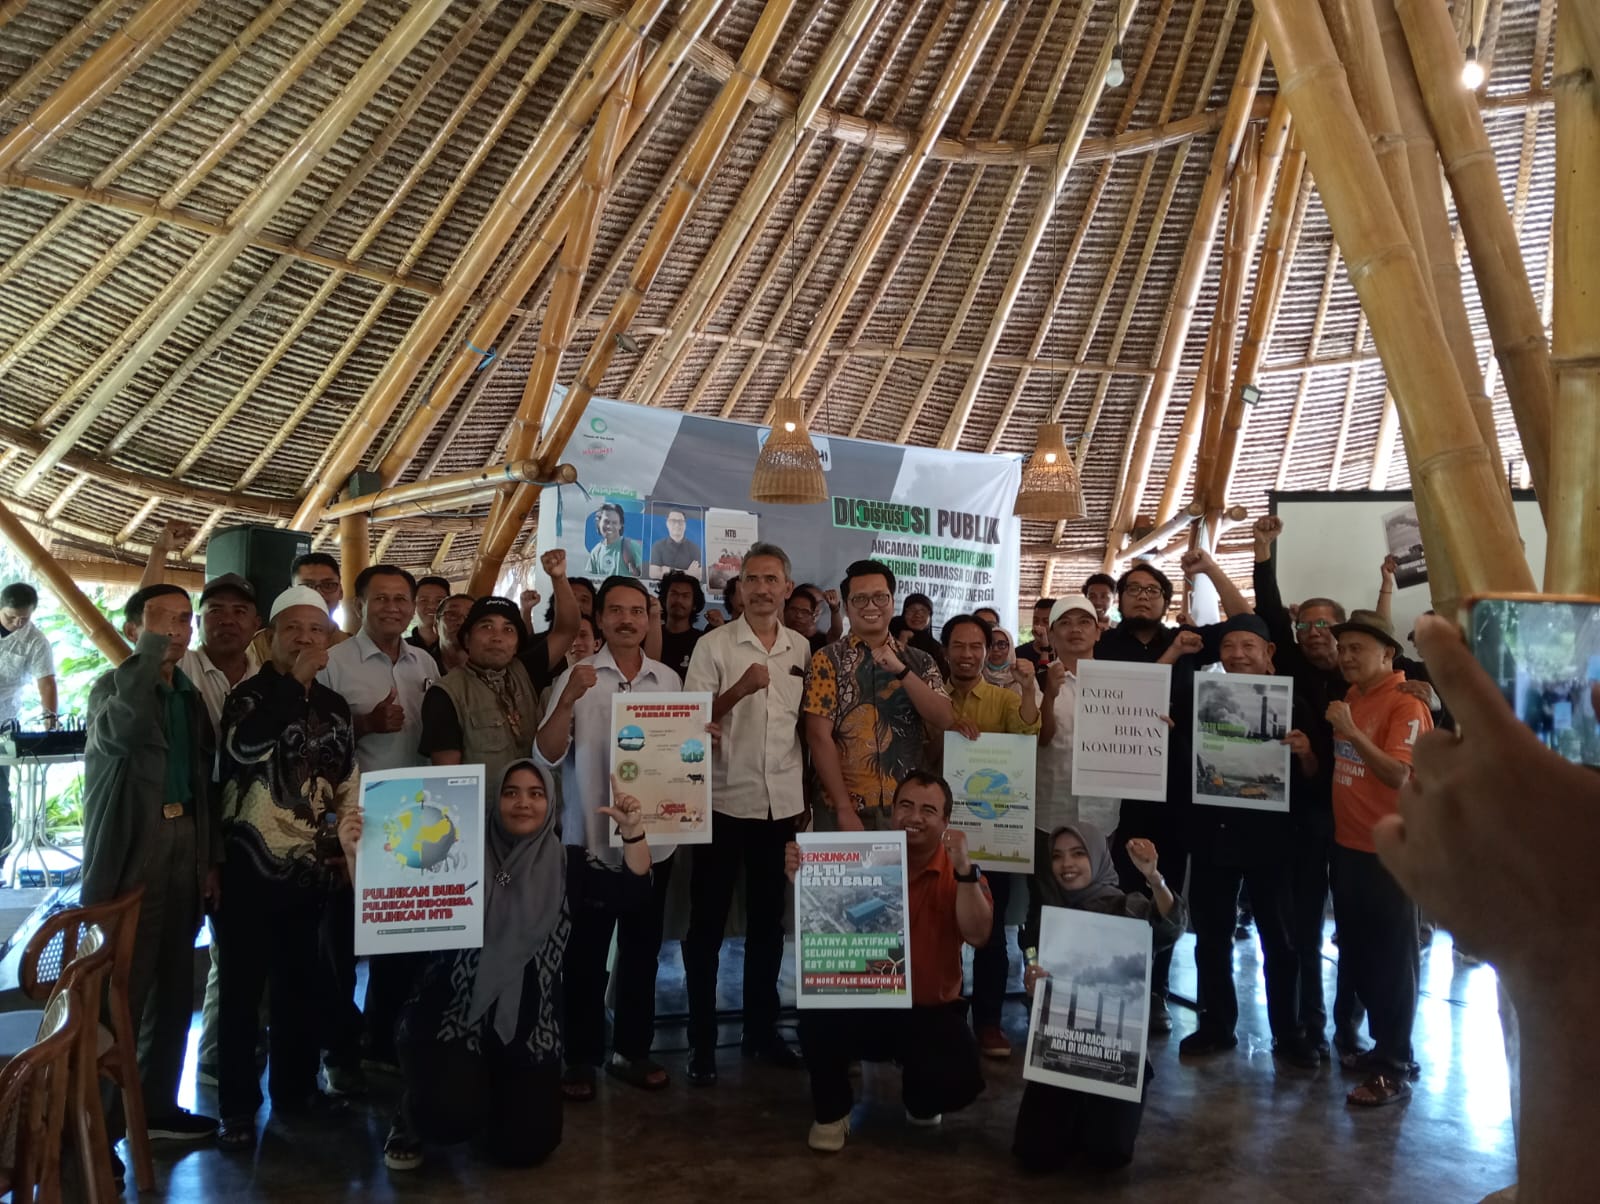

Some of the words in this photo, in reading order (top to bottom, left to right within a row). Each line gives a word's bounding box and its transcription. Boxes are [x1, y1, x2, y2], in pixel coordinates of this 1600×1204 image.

[937, 509, 1001, 545] PUBLIK
[872, 540, 919, 558] ANCAMAN
[921, 545, 942, 560] PLTU
[944, 547, 975, 566] CAPTIVE
[976, 553, 992, 568] DAN
[920, 564, 964, 581] BIOMASSA
[898, 580, 926, 595] PALSU
[965, 588, 995, 602] ENERGI
[1081, 688, 1123, 699] ENERGI
[1082, 704, 1131, 716] ADALAH
[1133, 707, 1159, 717] HAK
[1115, 725, 1161, 738] BUKAN
[801, 852, 860, 862] PENSIUNKAN
[802, 864, 846, 876] PLTU
[802, 876, 841, 886] BATU
[842, 876, 883, 886] BARA
[363, 885, 430, 900] PULIHKAN
[432, 884, 466, 896] BUMI
[363, 900, 415, 911] PULIHKAN
[362, 909, 426, 923] PULIHKAN
[429, 908, 453, 920] NTB
[805, 937, 847, 946] SAATNYA
[851, 937, 896, 946] AKTIFKAN
[805, 948, 845, 958] SELURUH
[848, 947, 887, 957] POTENSI
[805, 960, 823, 969] EBT
[826, 960, 835, 968] DI
[838, 960, 857, 968] NTB
[805, 977, 814, 985] NO
[816, 977, 834, 985] MORE
[836, 977, 857, 985] FALSE
[860, 977, 891, 985] SOLUTION
[1050, 1038, 1067, 1052] ADA
[1068, 1041, 1077, 1053] DI
[1077, 1043, 1103, 1059] UDARA
[1104, 1048, 1121, 1062] KITA
